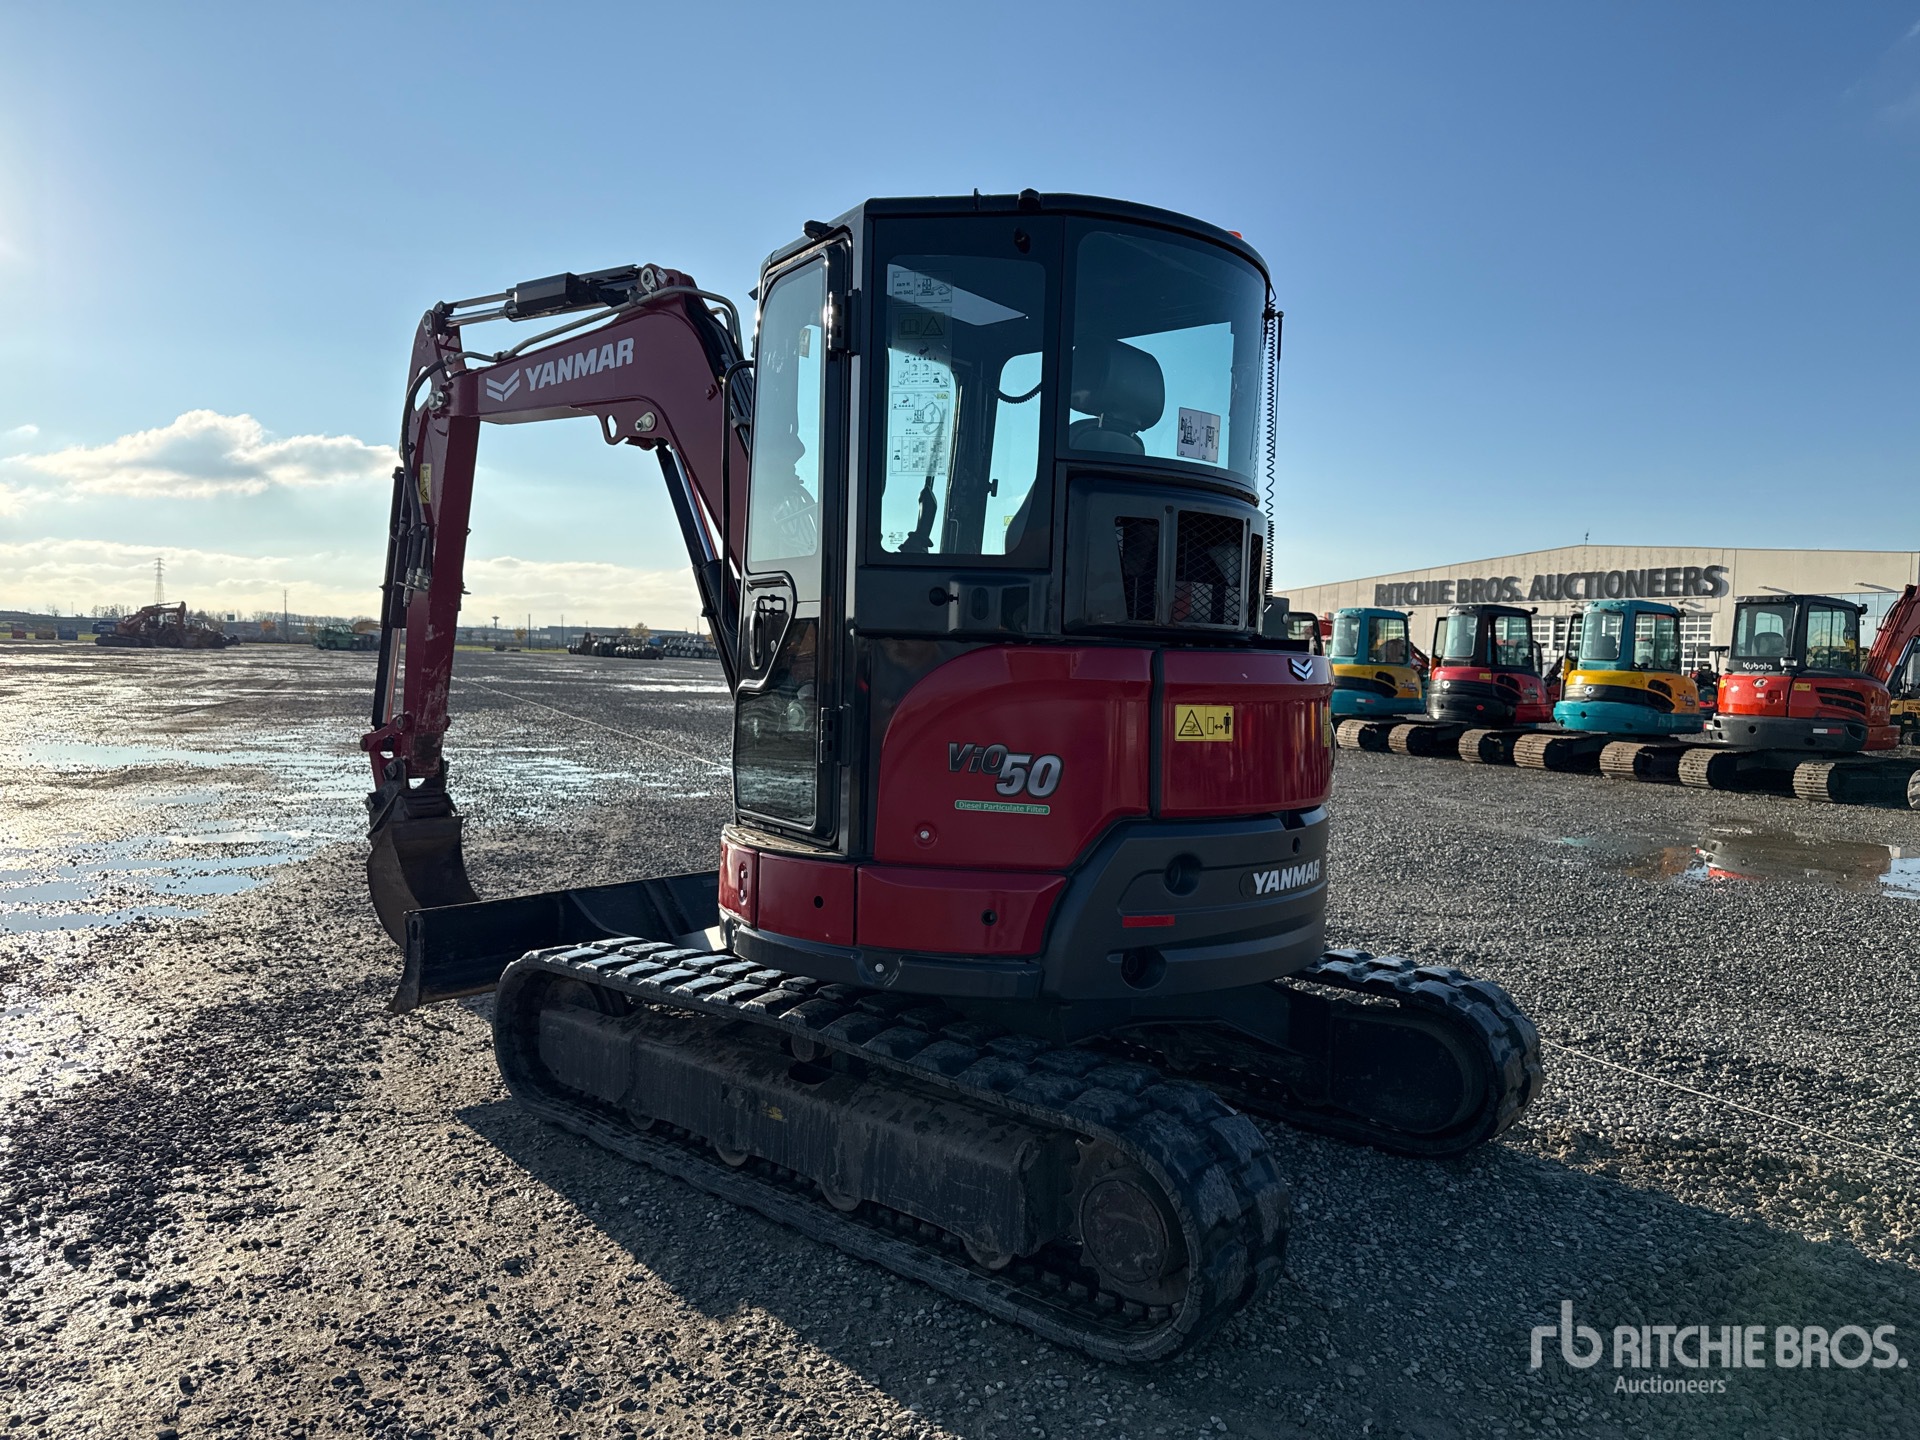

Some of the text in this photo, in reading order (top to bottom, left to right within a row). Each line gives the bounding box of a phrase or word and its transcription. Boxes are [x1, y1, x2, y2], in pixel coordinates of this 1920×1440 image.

[525, 337, 635, 392] YANMAR
[1374, 565, 1729, 606] RITCHIE BROS. AUCTIONEERS
[1742, 661, 1773, 671] Kubota
[983, 803, 1025, 812] Particulate
[1252, 858, 1321, 895] YANMAR
